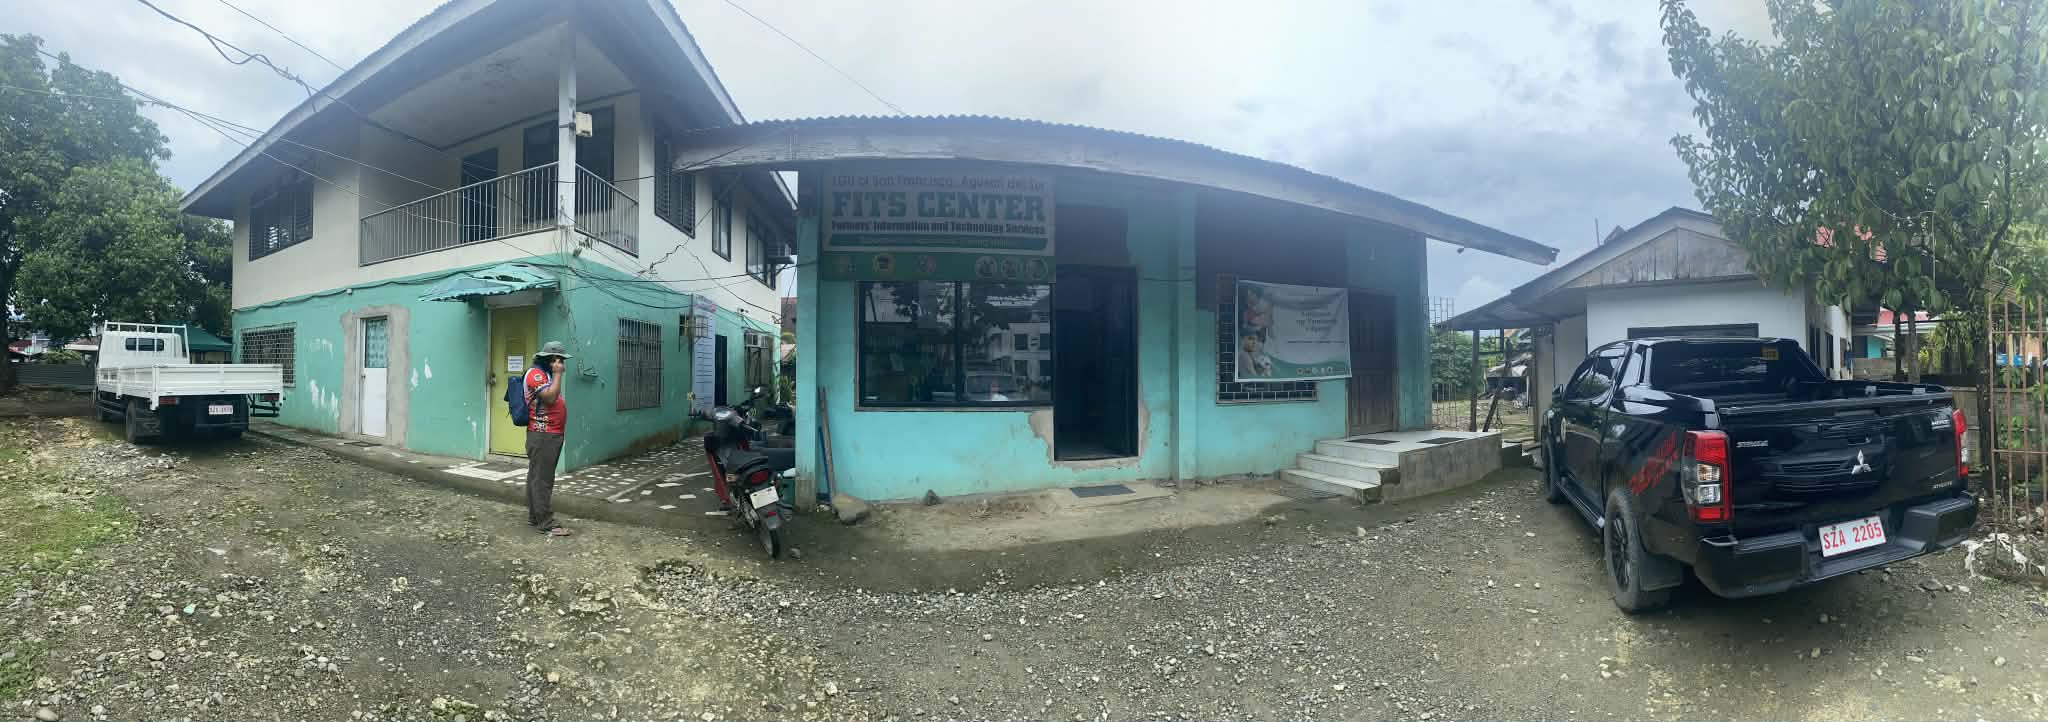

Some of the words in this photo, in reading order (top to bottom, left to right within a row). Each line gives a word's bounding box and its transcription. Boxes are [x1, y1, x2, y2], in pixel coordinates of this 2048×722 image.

[831, 191, 906, 217] FITS
[917, 191, 1045, 222] CENTER
[873, 220, 929, 232] Information
[930, 221, 949, 232] and
[951, 221, 1004, 235] Technology
[1005, 223, 1046, 235] Services
[1822, 530, 1846, 550] SZA
[1852, 522, 1882, 543] 2205
